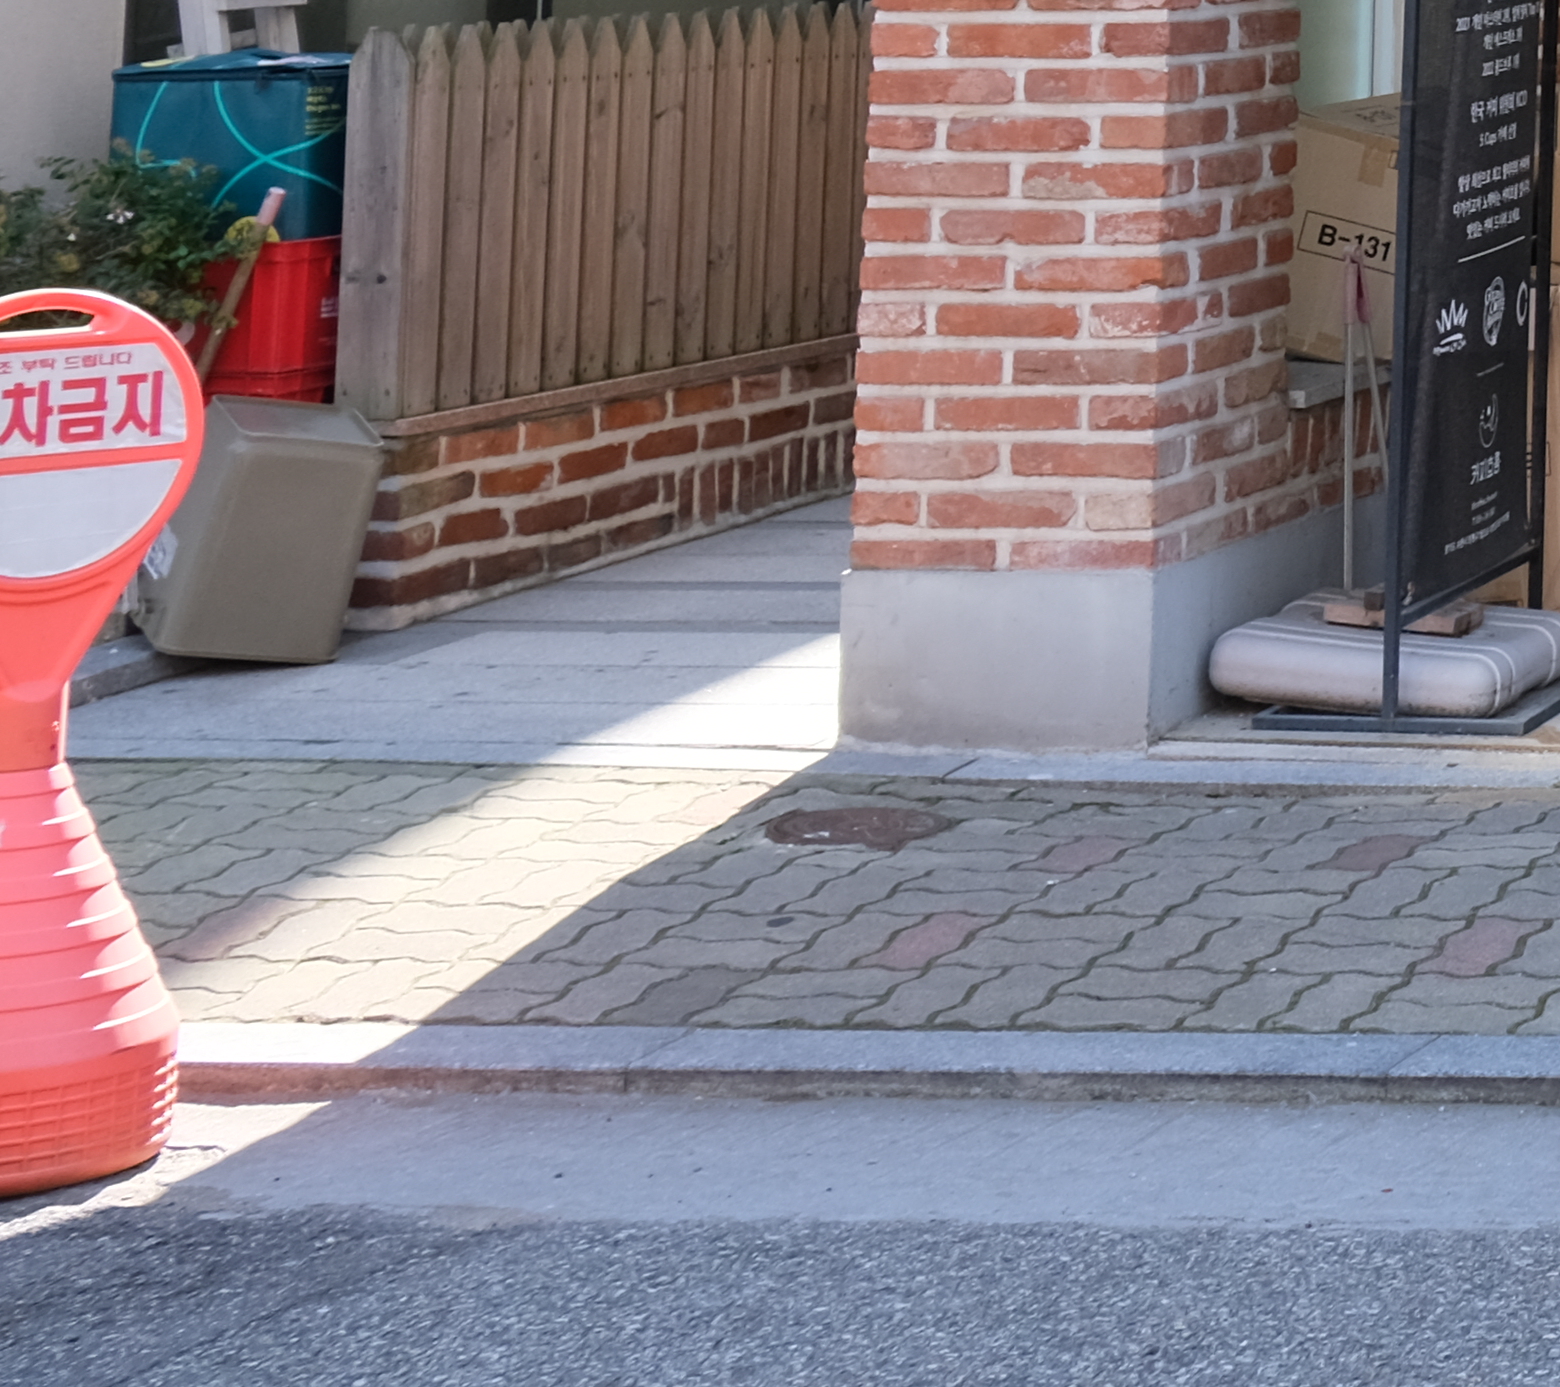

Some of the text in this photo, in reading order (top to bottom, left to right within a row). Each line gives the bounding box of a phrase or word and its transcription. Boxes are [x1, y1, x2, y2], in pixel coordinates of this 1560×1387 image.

[1317, 224, 1391, 261] B-131
[21, 358, 56, 373] 부탁
[63, 351, 132, 370] 드립니다
[0, 370, 163, 448] 차금지
